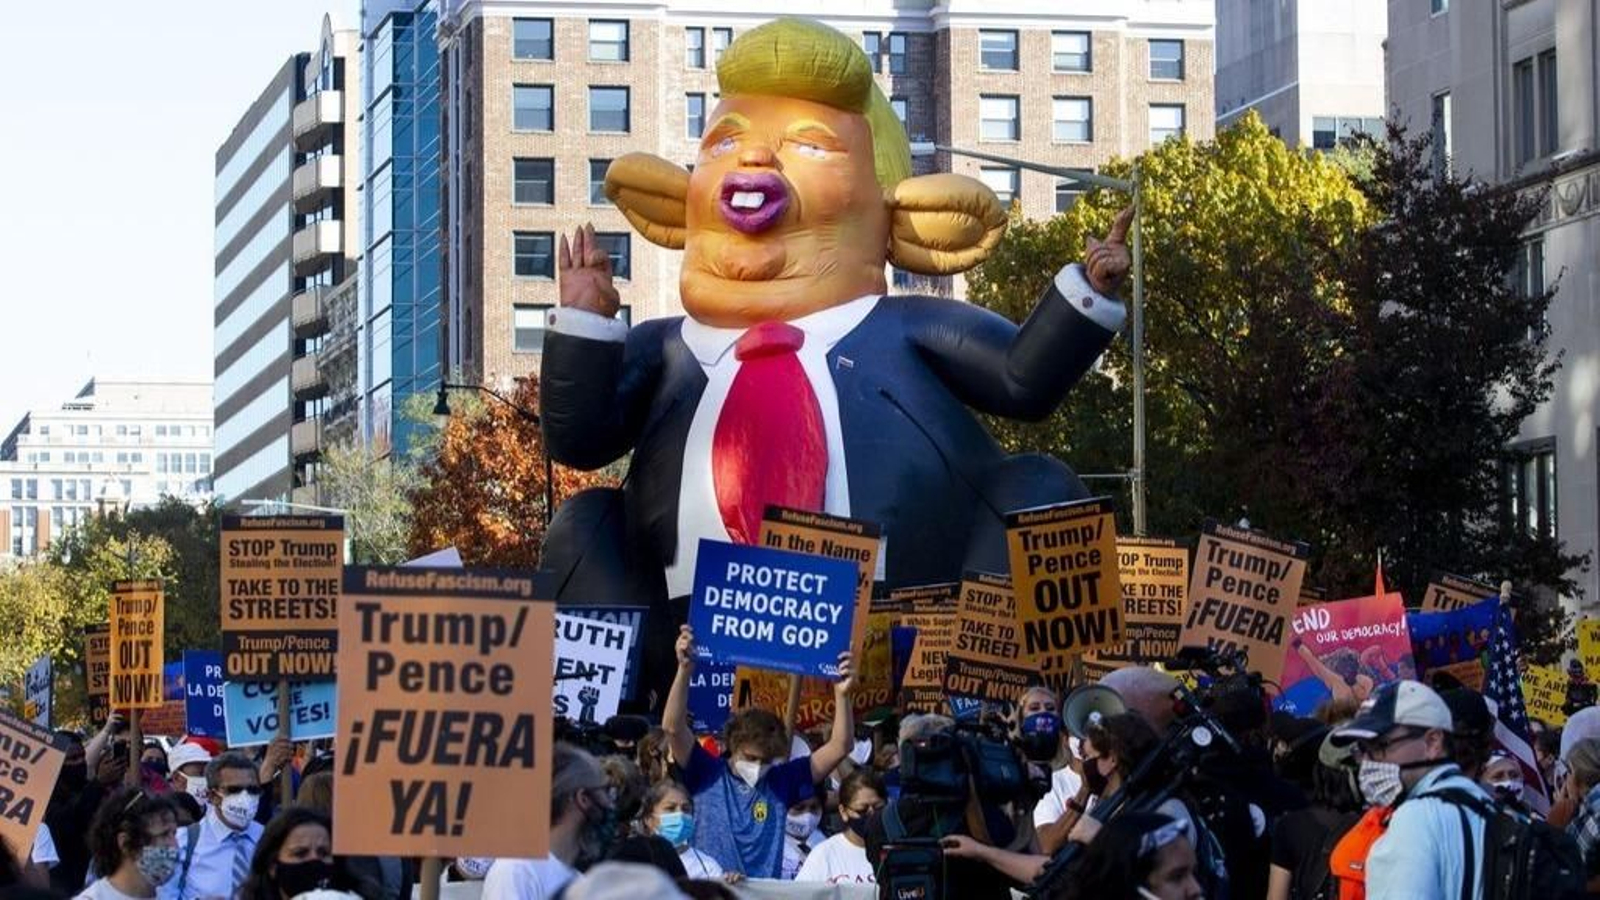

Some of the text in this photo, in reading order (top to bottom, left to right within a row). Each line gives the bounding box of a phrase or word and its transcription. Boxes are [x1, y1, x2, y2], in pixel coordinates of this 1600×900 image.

[765, 530, 871, 562] In the Name
[1018, 518, 1104, 552] Trump/
[229, 539, 337, 558] STOP Trump
[1207, 540, 1293, 582] Trump/
[274, 559, 290, 568] the
[1028, 549, 1101, 575] Pence
[1143, 554, 1183, 570] Trump
[228, 579, 338, 596] TAKE TO THE
[365, 570, 532, 597] RefuseFascism.org
[726, 562, 828, 595] PROTECT
[1140, 583, 1157, 597] TO
[1159, 584, 1183, 598] THE
[1206, 566, 1280, 605] Pence
[965, 589, 1003, 607] STOP
[1034, 571, 1101, 613] OUT
[115, 594, 159, 617] Trump/
[229, 598, 337, 619] STREETS!
[704, 586, 842, 625] DEMOCRACY
[1125, 598, 1182, 616] REETS!
[118, 618, 154, 635] Pence
[355, 602, 530, 655] Trump/
[712, 614, 829, 649] FROM GOP
[960, 618, 1015, 640] TAKE TO
[1024, 608, 1120, 654] NOW!
[1186, 597, 1285, 646] ¡FUERA
[1292, 608, 1330, 634] END
[1316, 614, 1406, 644] OUR DEMOCRACY!
[119, 639, 152, 669] OUT
[238, 635, 330, 651] Trump/Pence
[228, 652, 272, 675] OUT
[366, 651, 515, 695] Pence
[960, 662, 1028, 684] Trump/Pence
[113, 674, 160, 703] NOW!
[187, 684, 203, 697] LA
[689, 673, 707, 687] LA
[948, 673, 983, 695] OUT
[1545, 680, 1565, 693] ARE
[270, 691, 303, 710] TE
[1532, 687, 1551, 700] THE
[246, 702, 331, 735] VOES!
[343, 709, 536, 776] ¡FUERA
[390, 780, 473, 837] YA!
